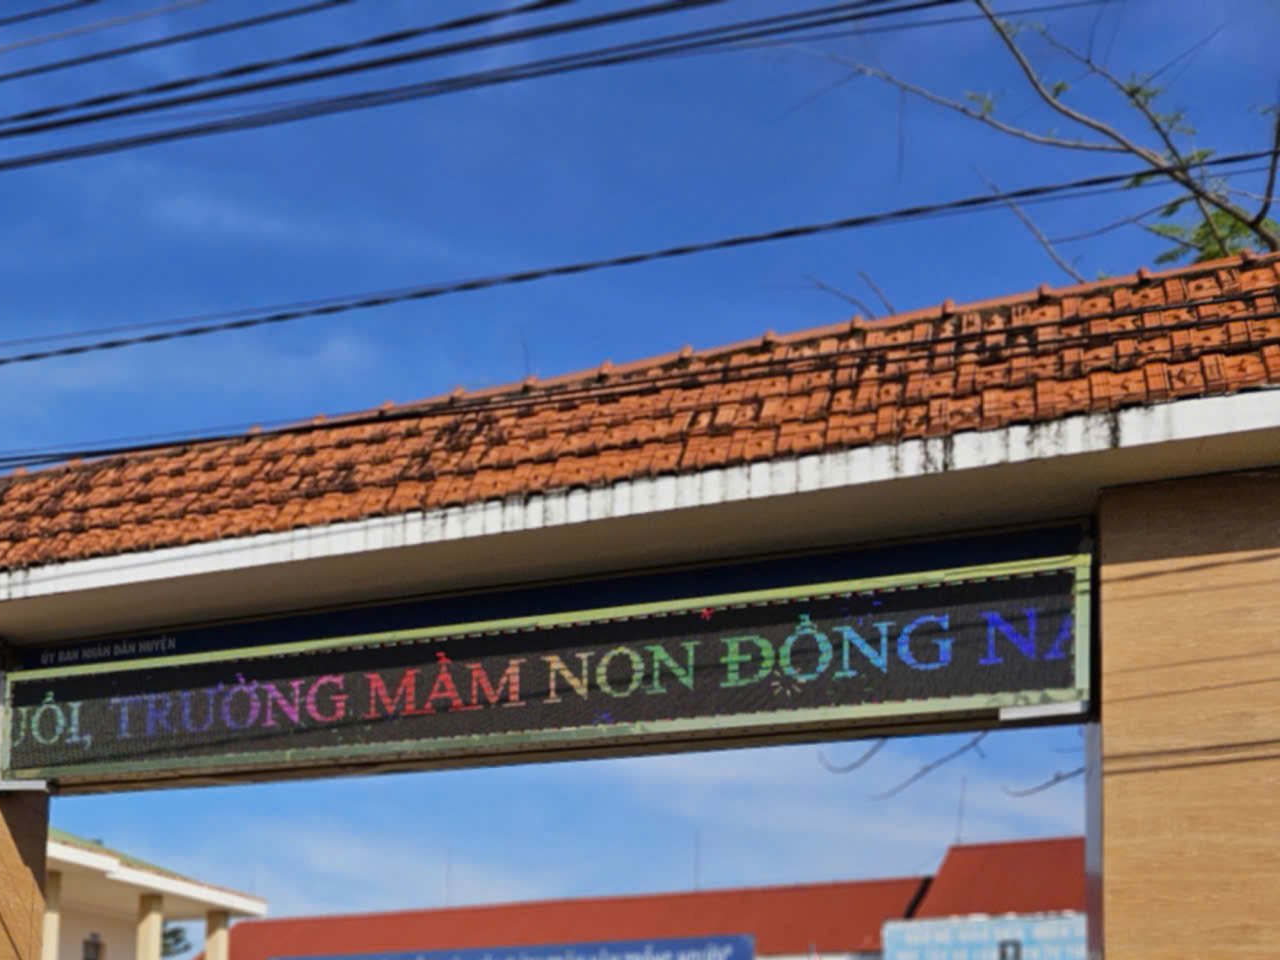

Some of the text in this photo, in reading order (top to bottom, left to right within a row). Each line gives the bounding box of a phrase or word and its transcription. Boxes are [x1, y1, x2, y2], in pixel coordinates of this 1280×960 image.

[58, 648, 79, 663] BAN
[108, 673, 350, 738] TRƯỜNG
[363, 652, 527, 722] MẦM
[542, 640, 701, 704] NON
[719, 613, 957, 689] ĐỒNG
